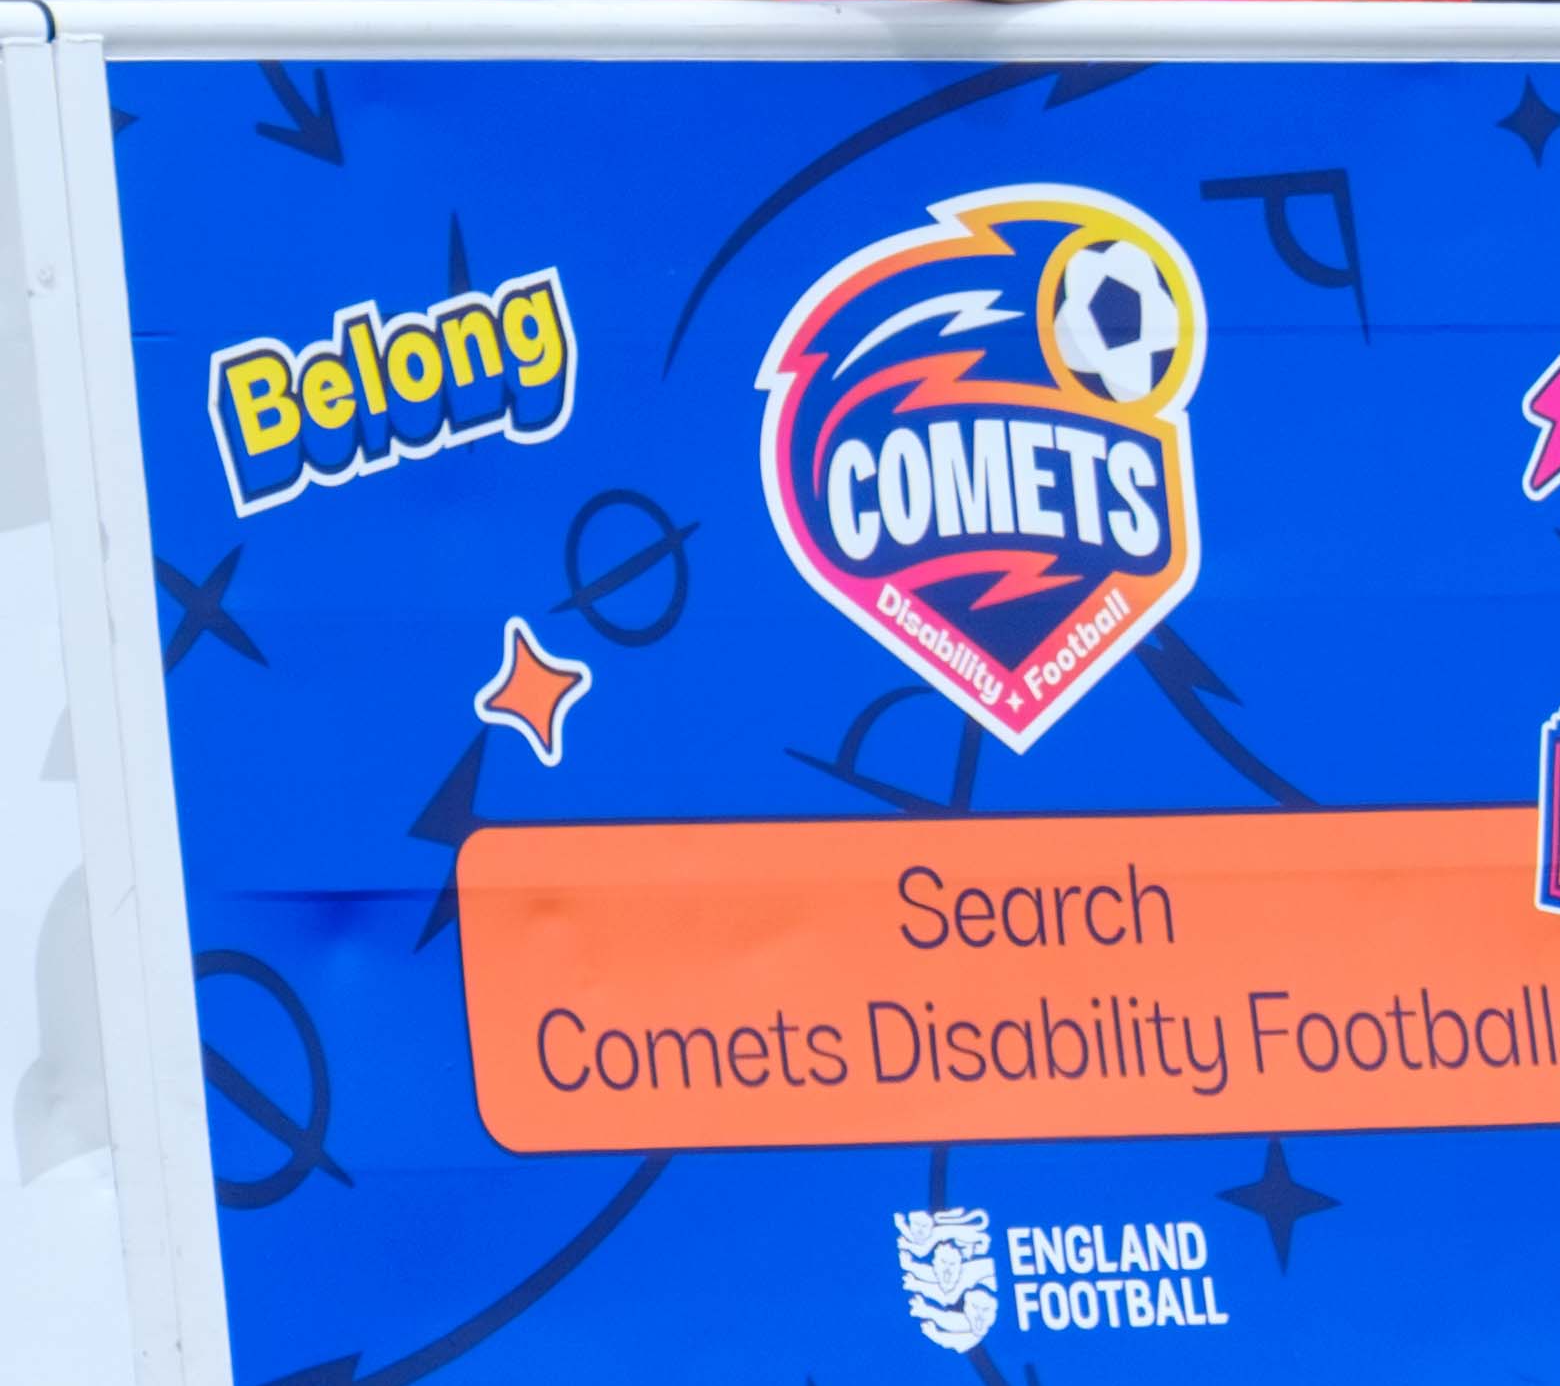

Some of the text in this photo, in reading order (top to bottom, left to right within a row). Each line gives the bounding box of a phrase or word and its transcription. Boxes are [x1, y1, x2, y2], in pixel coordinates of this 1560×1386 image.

[224, 281, 568, 473] Belong
[828, 419, 1159, 560] COMETS
[876, 583, 1132, 707] Disability Football
[898, 863, 1176, 951] Search
[536, 984, 1559, 1097] Comets Disability Football
[1007, 1222, 1208, 1276] ENGLAND
[1014, 1274, 1230, 1332] FOOTBALL
